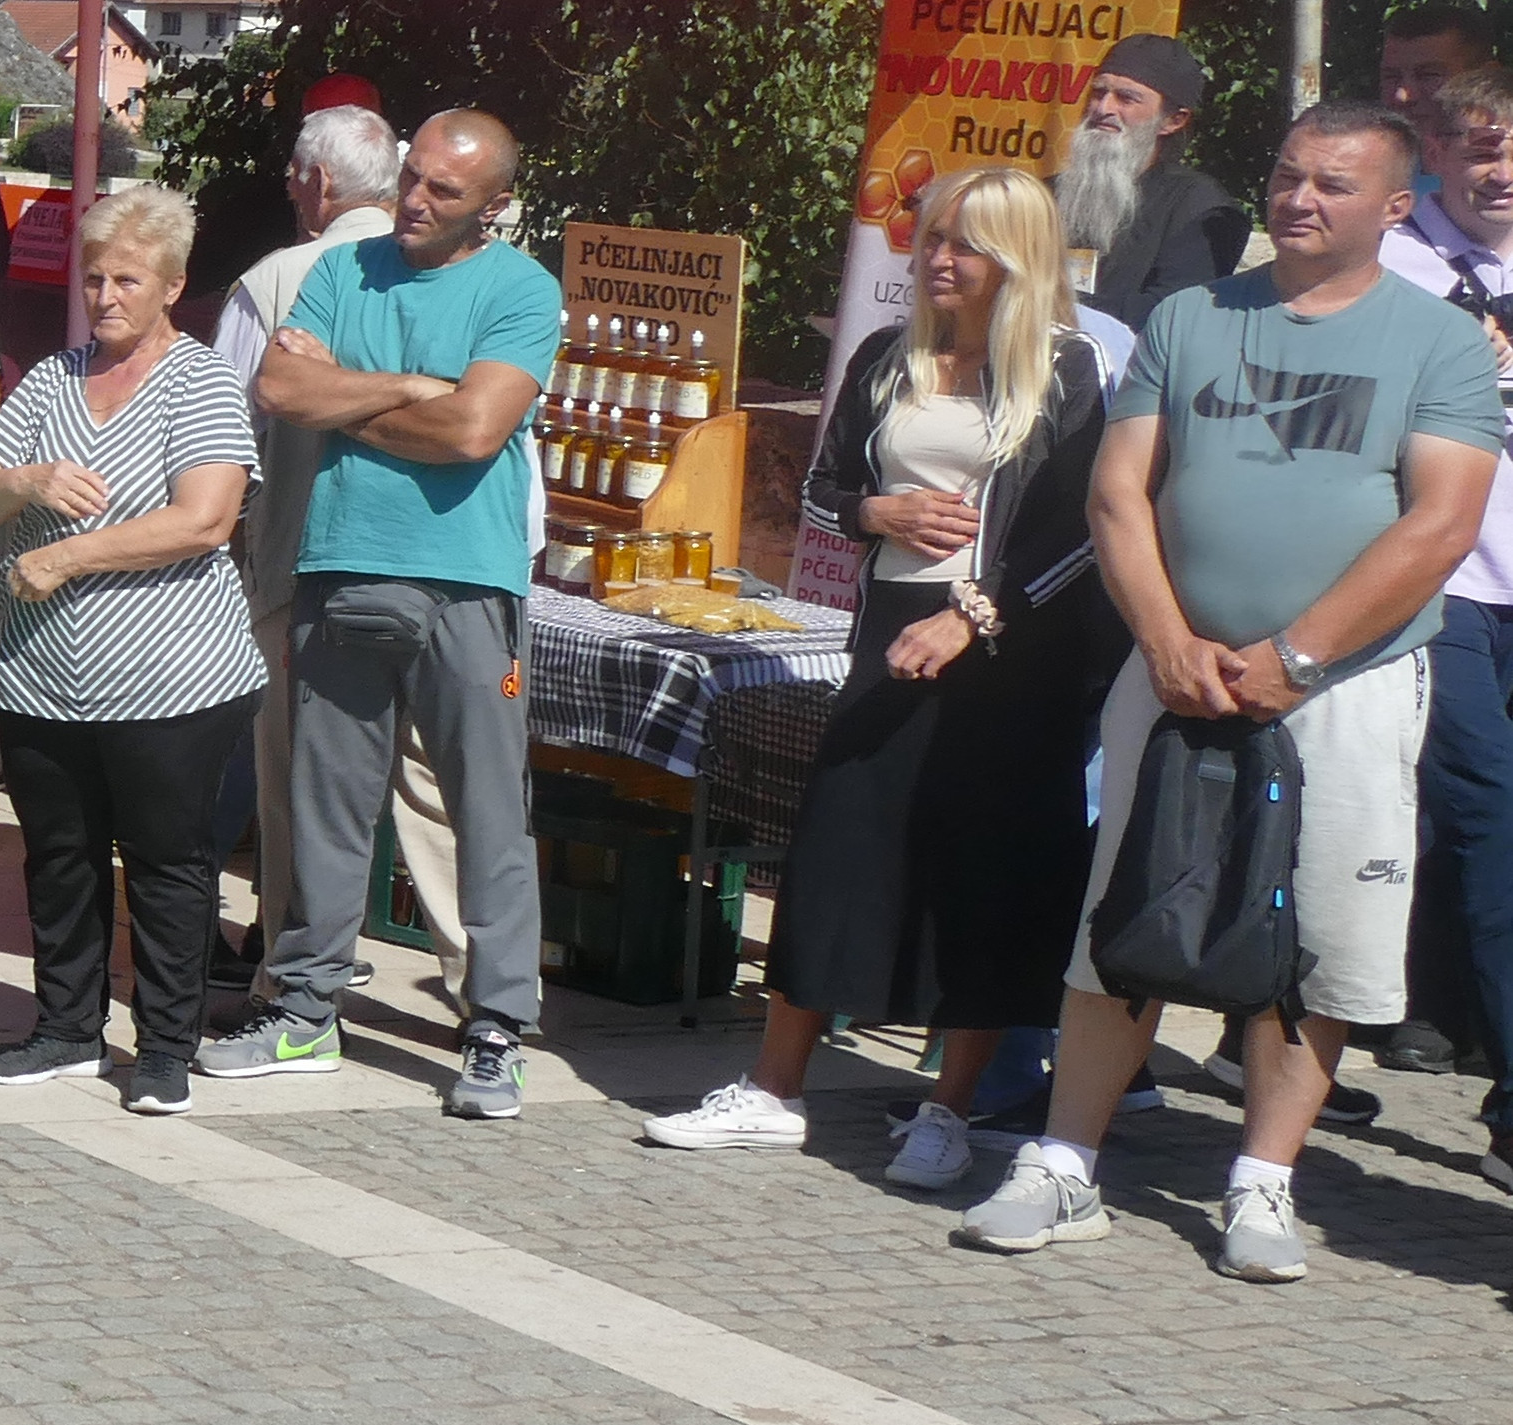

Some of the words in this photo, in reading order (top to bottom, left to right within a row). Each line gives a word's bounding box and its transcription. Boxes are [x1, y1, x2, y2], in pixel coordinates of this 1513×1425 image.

[949, 115, 1047, 160] Rudo
[578, 234, 724, 281] PČELINJACI
[1364, 859, 1399, 872] NIKE
[1384, 872, 1407, 884] AIR
